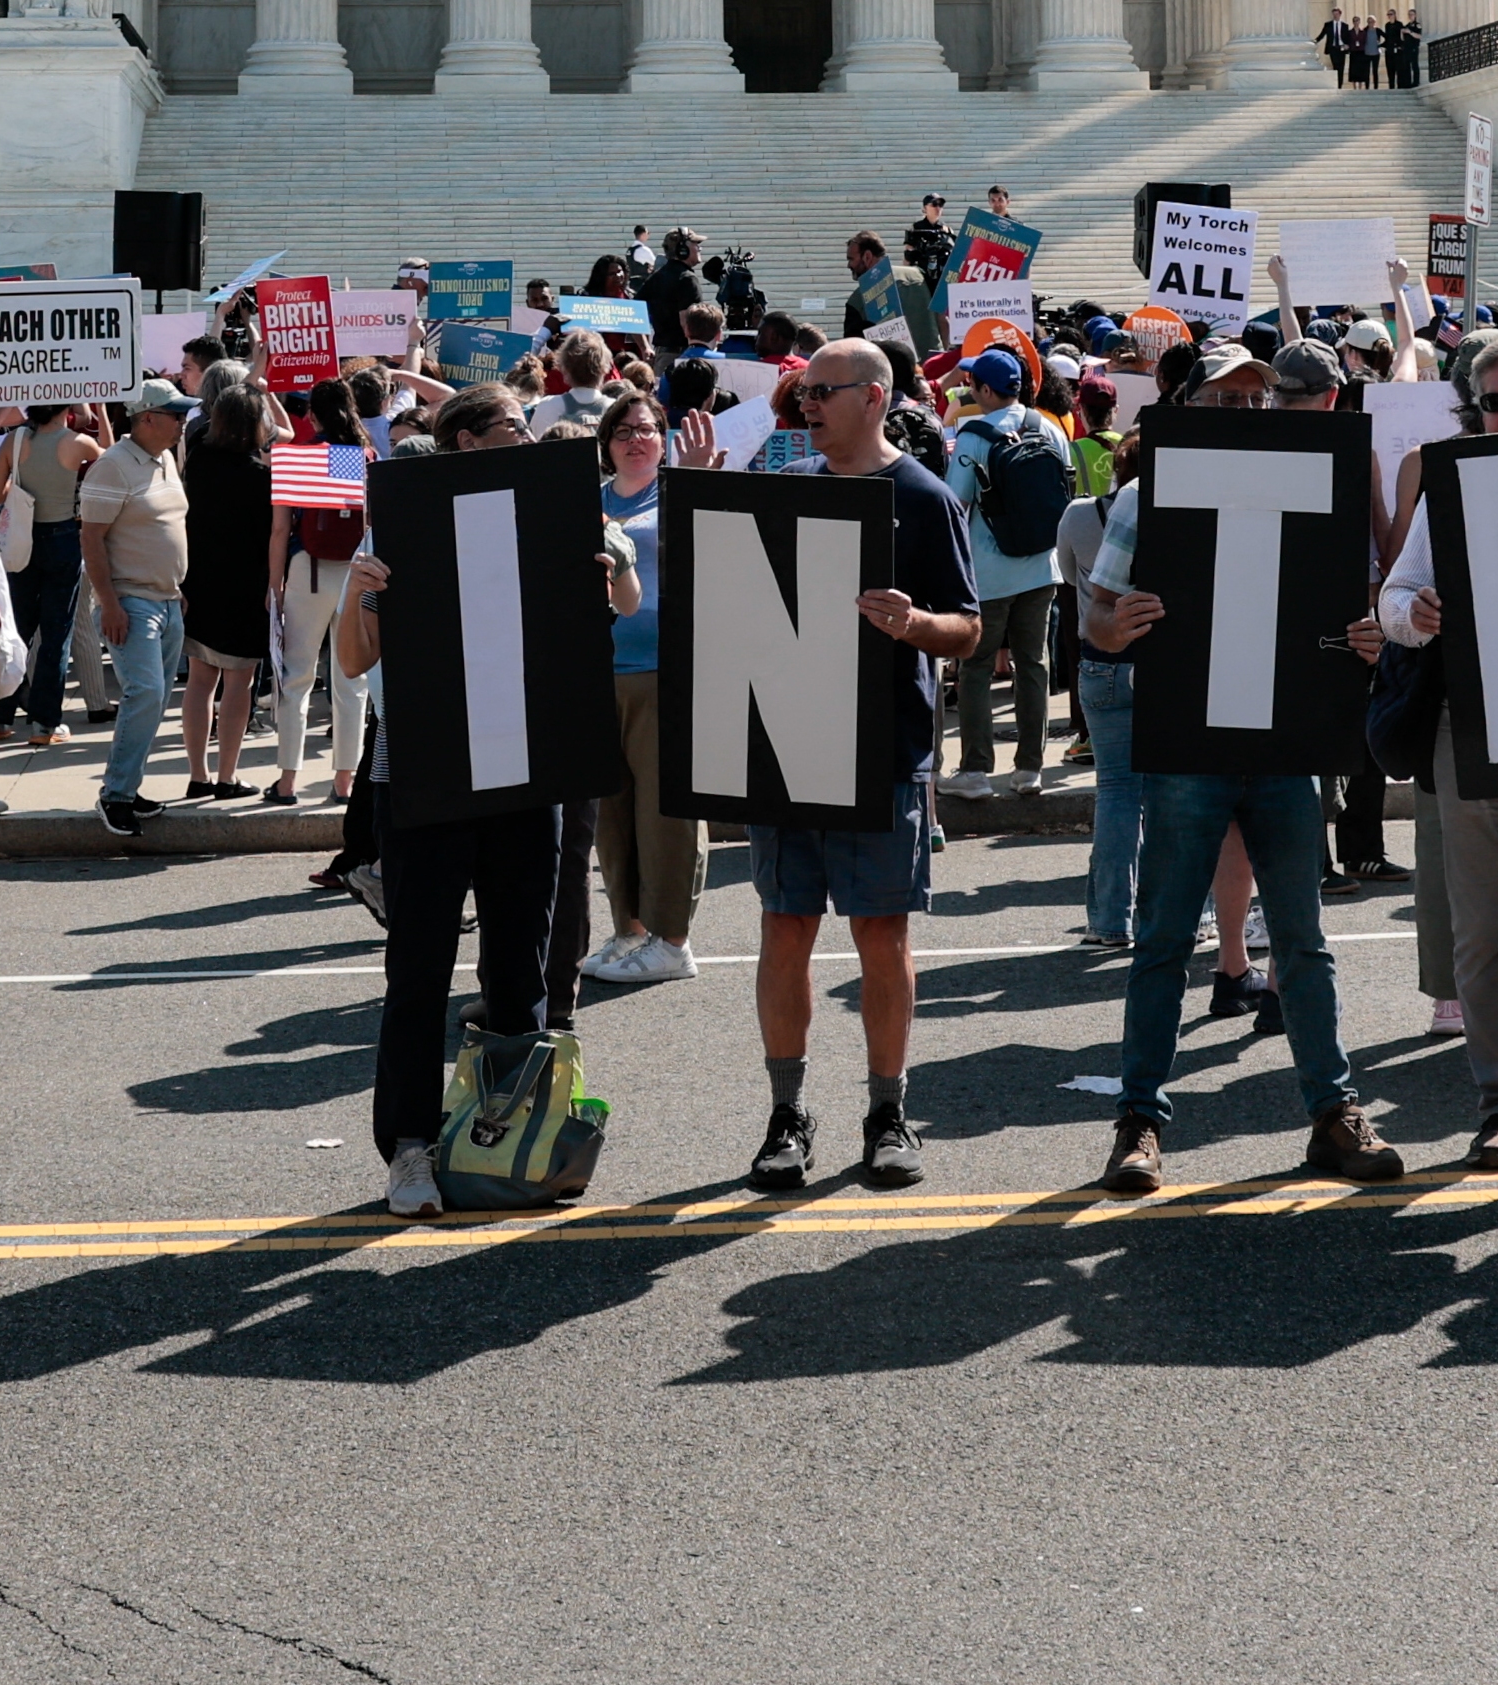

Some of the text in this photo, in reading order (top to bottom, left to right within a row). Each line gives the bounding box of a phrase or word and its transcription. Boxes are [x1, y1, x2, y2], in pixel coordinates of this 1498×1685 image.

[1475, 123, 1485, 145] NO
[1470, 145, 1490, 168] PARKING
[1473, 169, 1483, 185] ANY
[1472, 185, 1483, 202] TIME
[1166, 212, 1249, 233] My Torch
[1432, 223, 1467, 240] ¡QUE S
[1164, 236, 1247, 256] Welcomes
[1432, 241, 1466, 258] LARGU
[1432, 258, 1465, 275] TRUM
[431, 278, 510, 293] CONSTITUTIONNEL
[1157, 262, 1244, 301] ALL
[275, 290, 312, 302] Protect
[457, 293, 483, 306] DROIT
[960, 297, 1021, 308] It's literally in
[264, 301, 327, 329] BIRTH
[955, 308, 1028, 319] the Constitution.
[1184, 308, 1203, 317] Kids
[1229, 313, 1241, 321] Go
[50, 308, 121, 341] OTHER
[878, 321, 906, 338] RIGHTS
[1132, 316, 1182, 336] RESPECT
[267, 327, 330, 354] RIGHT
[272, 353, 330, 367] Citizenship
[468, 352, 499, 370] RIGHT
[293, 374, 313, 384] ACLU
[33, 381, 119, 401] CONDUCTOR
